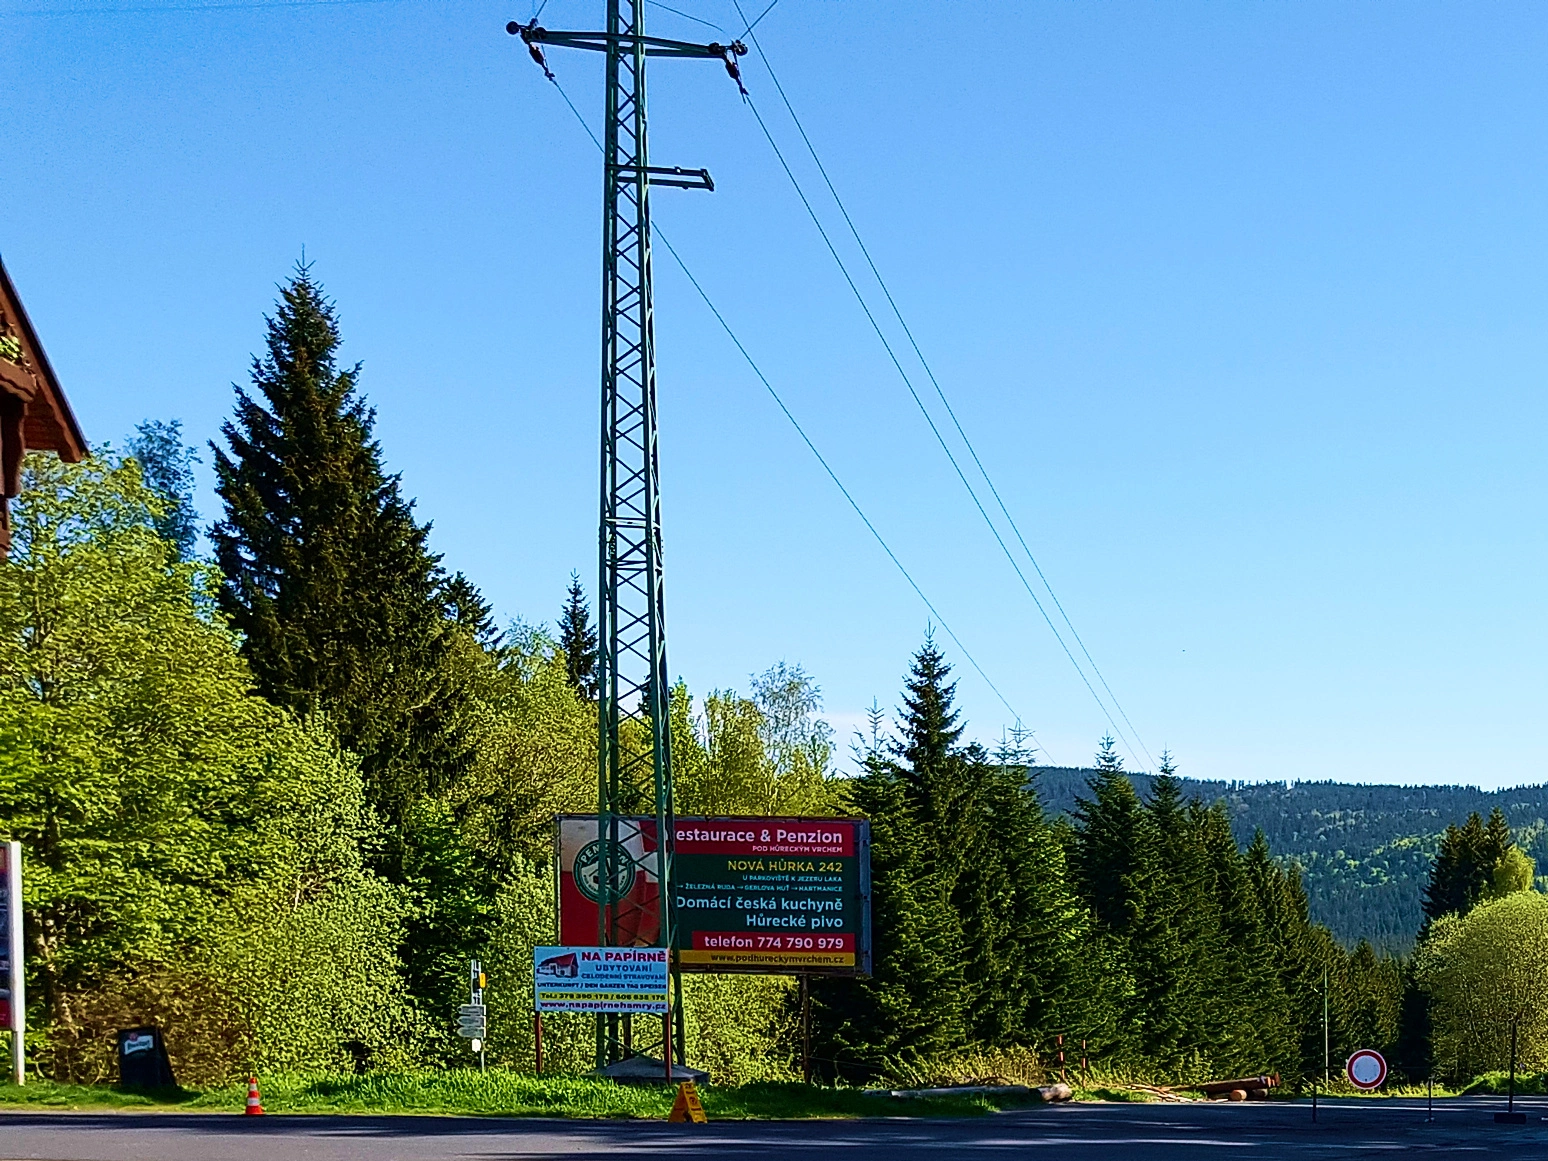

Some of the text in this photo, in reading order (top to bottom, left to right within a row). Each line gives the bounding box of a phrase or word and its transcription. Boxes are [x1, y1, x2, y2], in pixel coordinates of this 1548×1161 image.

[671, 828, 842, 843] estaurace & Penzion
[727, 858, 843, 873] NOVÁ HŮRKA 242
[685, 882, 716, 890] ŽELEZNÁ
[676, 896, 843, 913] Domácí česká kuchyně
[746, 913, 843, 929] Hůrecké pivo
[704, 936, 844, 949] telefon 774 790 979
[581, 950, 666, 962] NA PAPÍRNĚ
[710, 953, 844, 964] www.podhureckymvrchem.cz
